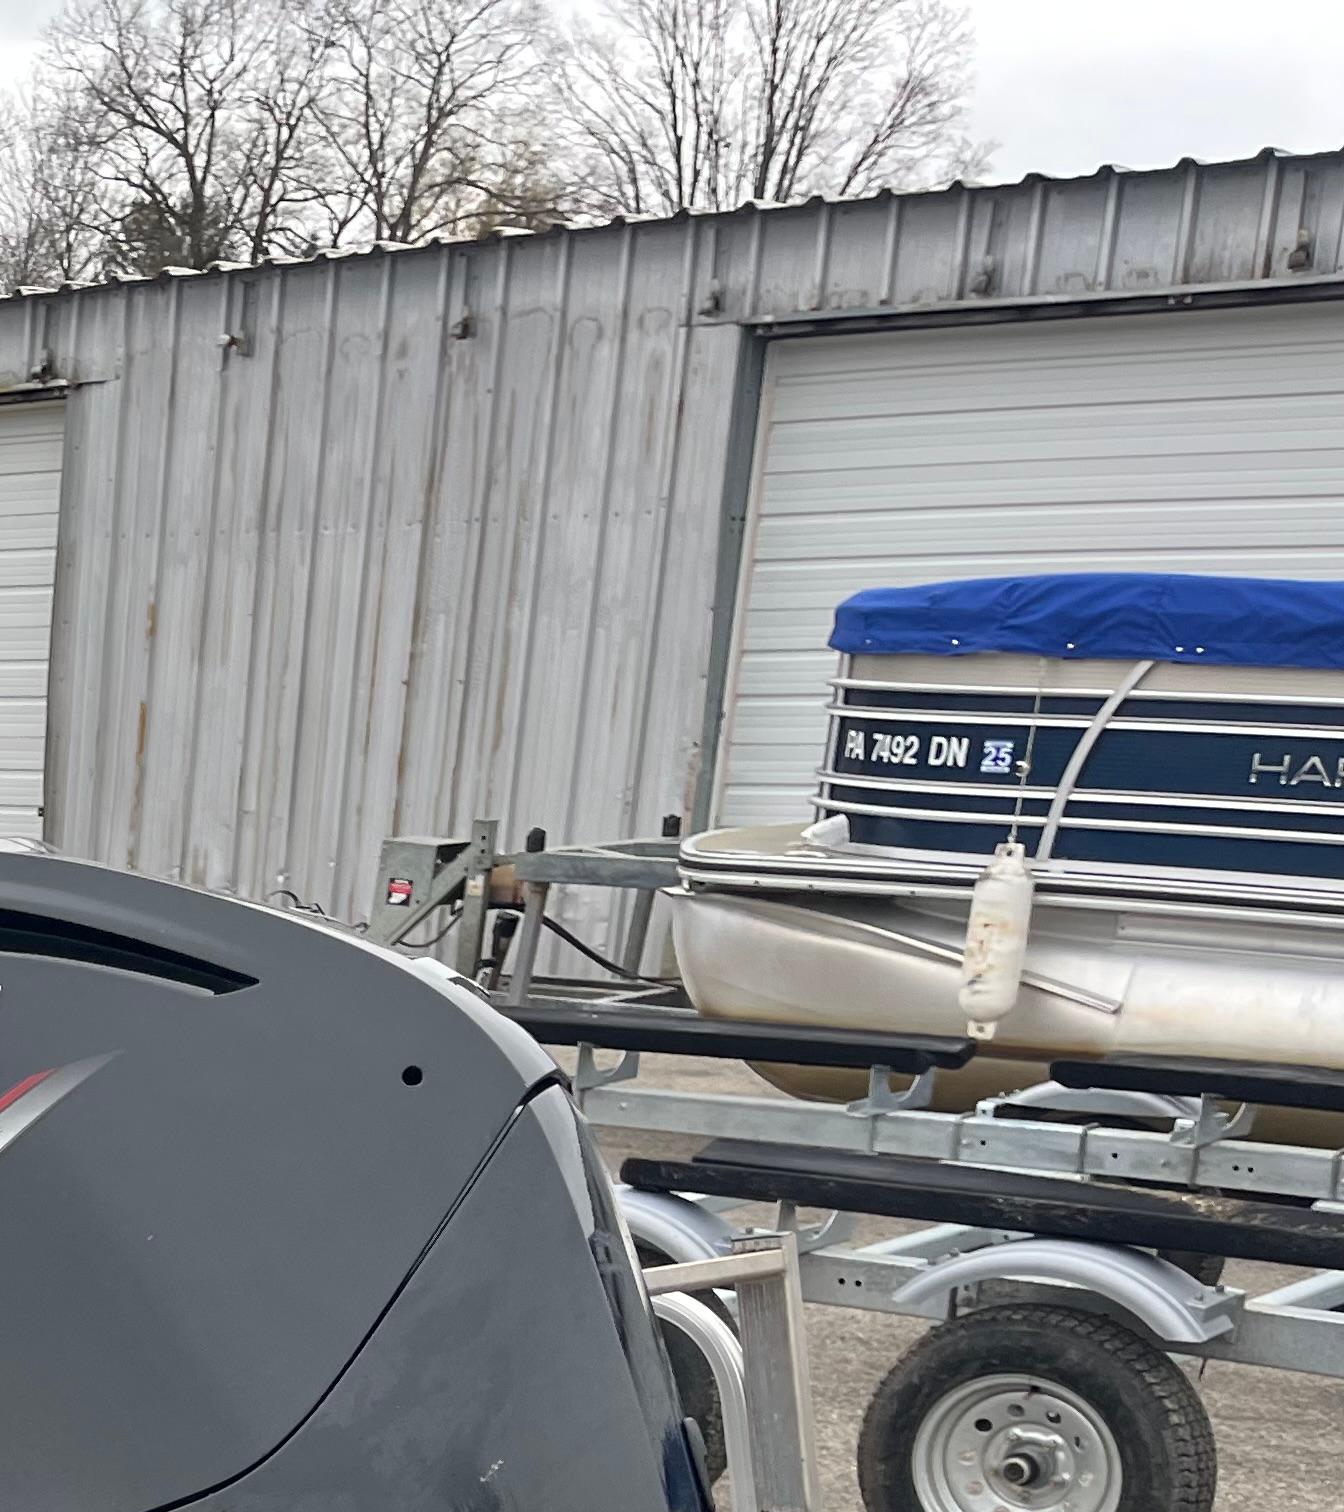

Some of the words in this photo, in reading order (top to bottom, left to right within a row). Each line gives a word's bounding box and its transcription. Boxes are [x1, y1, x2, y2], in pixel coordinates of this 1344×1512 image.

[844, 729, 865, 760] PA
[870, 732, 920, 765] 7492
[927, 736, 970, 767] DN
[981, 746, 1012, 767] 25
[1248, 752, 1344, 788] HA
